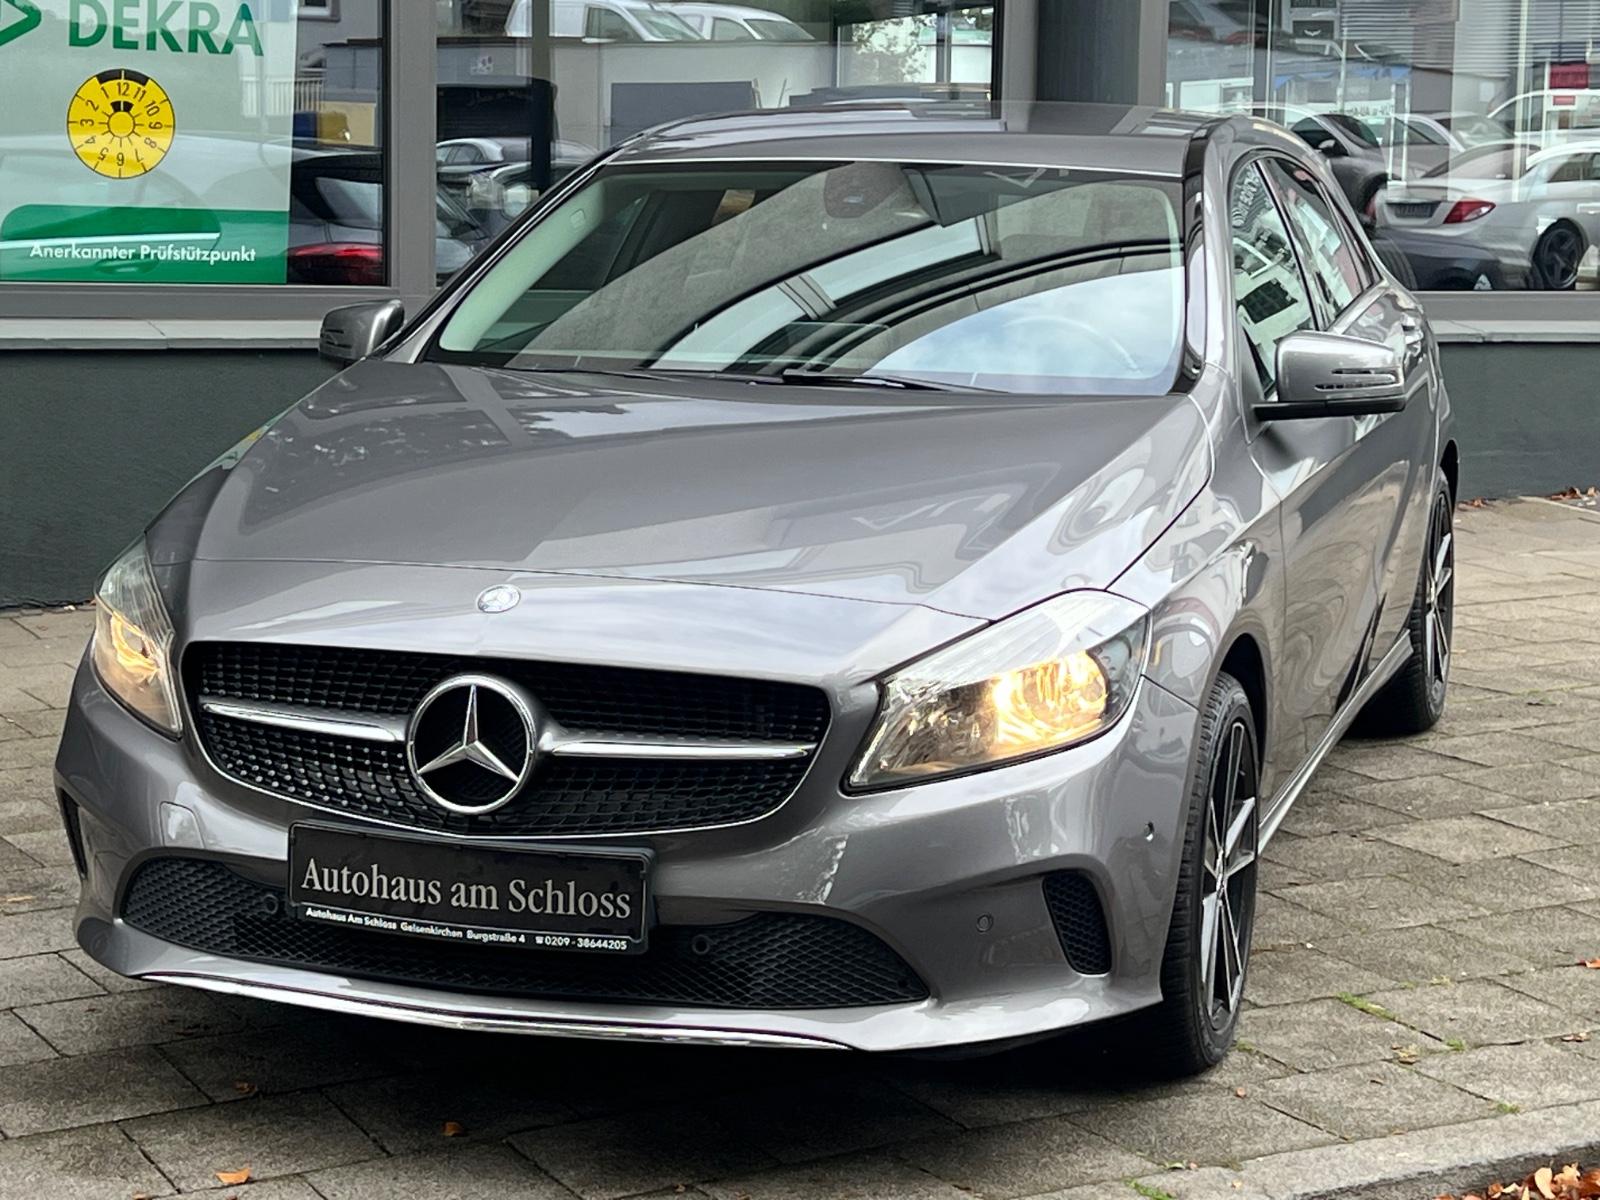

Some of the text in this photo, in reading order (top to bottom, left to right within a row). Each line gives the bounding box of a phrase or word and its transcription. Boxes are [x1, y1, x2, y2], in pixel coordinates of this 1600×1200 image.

[69, 0, 264, 56] DEKRA
[100, 86, 110, 99] 1
[116, 82, 130, 96] 12
[133, 87, 146, 102] 11
[86, 100, 99, 112] 2
[144, 100, 160, 117] 10
[80, 118, 94, 127] 3
[148, 122, 163, 130] 9
[84, 135, 96, 144] 4
[144, 137, 157, 149] 8
[98, 147, 109, 160] 5
[116, 152, 124, 166] 6
[134, 148, 144, 163] 7
[30, 242, 256, 265] Anerkannter Prüfstützpunkt
[301, 858, 630, 919] Autohaus am Schloss
[306, 907, 346, 922] Autohaus
[348, 914, 364, 925] Am
[364, 916, 396, 930] Schloss
[400, 922, 463, 938] Gelsenkirchen
[466, 930, 517, 943] Burgstraße
[518, 934, 526, 943] 4
